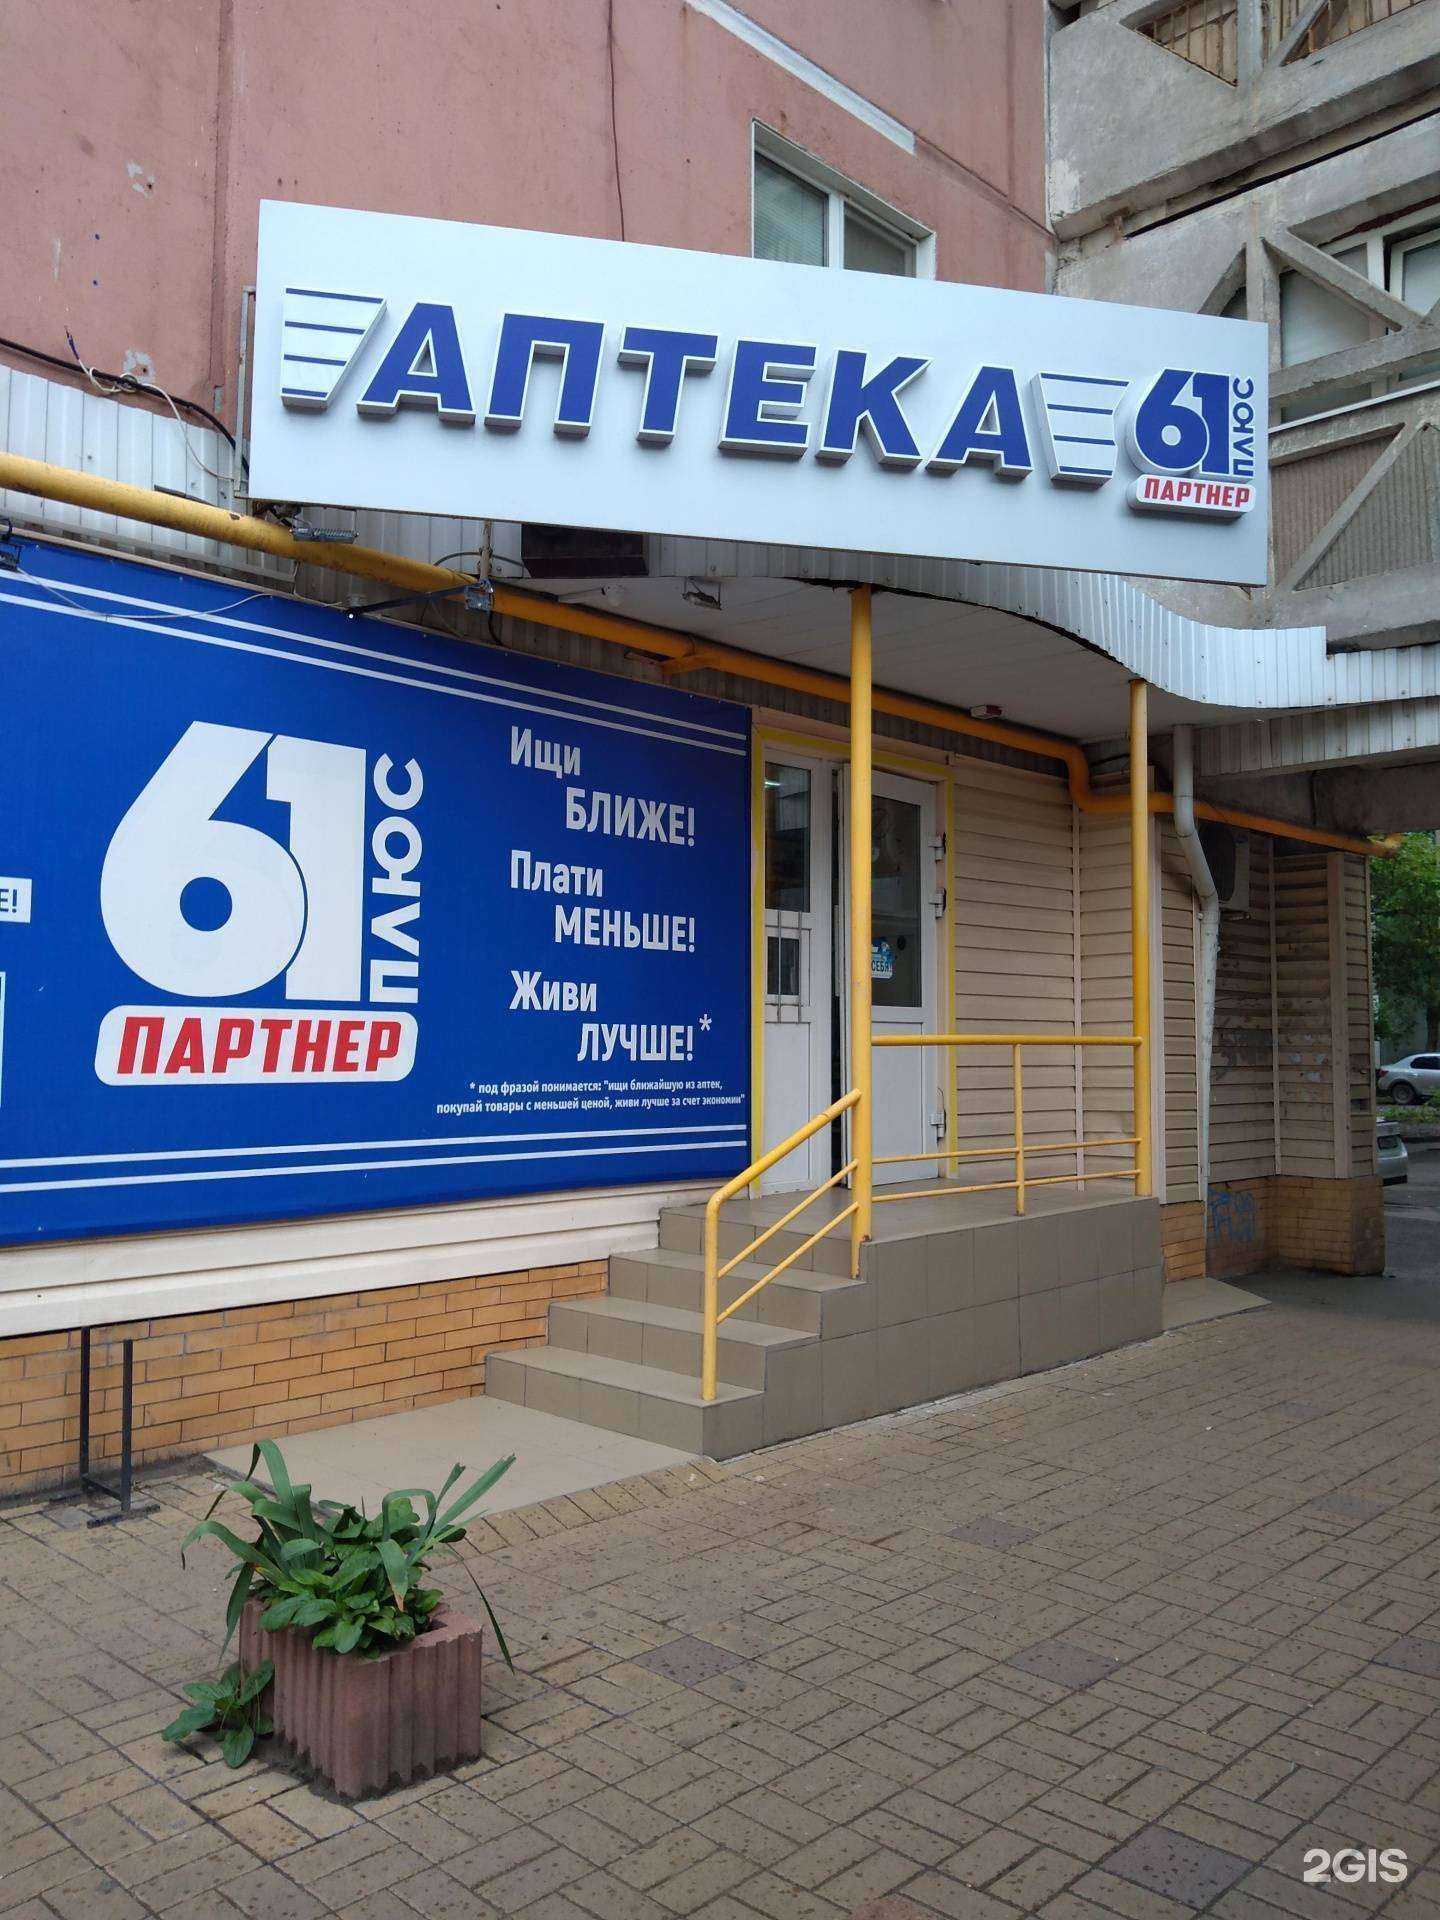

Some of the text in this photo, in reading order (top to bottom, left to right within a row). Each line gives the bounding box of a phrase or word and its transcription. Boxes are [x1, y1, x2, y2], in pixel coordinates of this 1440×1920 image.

[356, 300, 1034, 476] АПТЕКА
[1135, 368, 1230, 475] 61
[1232, 377, 1255, 478] ПЛЮС
[1144, 477, 1250, 508] ПАРТНЕР
[510, 725, 581, 779] Ищи
[565, 786, 696, 847] БЛИЖЕ!
[100, 720, 367, 1002] 61
[369, 752, 424, 1004] ПЛЮС
[510, 849, 604, 897] Плати
[554, 904, 696, 953] МЕНЬШЕ!
[509, 970, 597, 1012] Живи
[116, 1016, 403, 1075] ПАРТНЕР
[436, 1100, 483, 1116] покупай
[485, 1101, 524, 1114] товары
[526, 1101, 532, 1111] с
[533, 1097, 579, 1111] меньшей
[581, 1096, 613, 1110] ценой,
[615, 1098, 640, 1108] живи
[641, 1097, 670, 1110] лучше
[671, 1097, 681, 1107] за
[682, 1096, 700, 1107] счет
[478, 1083, 498, 1096] под
[500, 1080, 539, 1096] фразой
[541, 1081, 602, 1093] понимается:
[630, 1079, 684, 1092] ближайшую
[685, 1080, 696, 1090] из
[697, 1079, 723, 1091] аптек,
